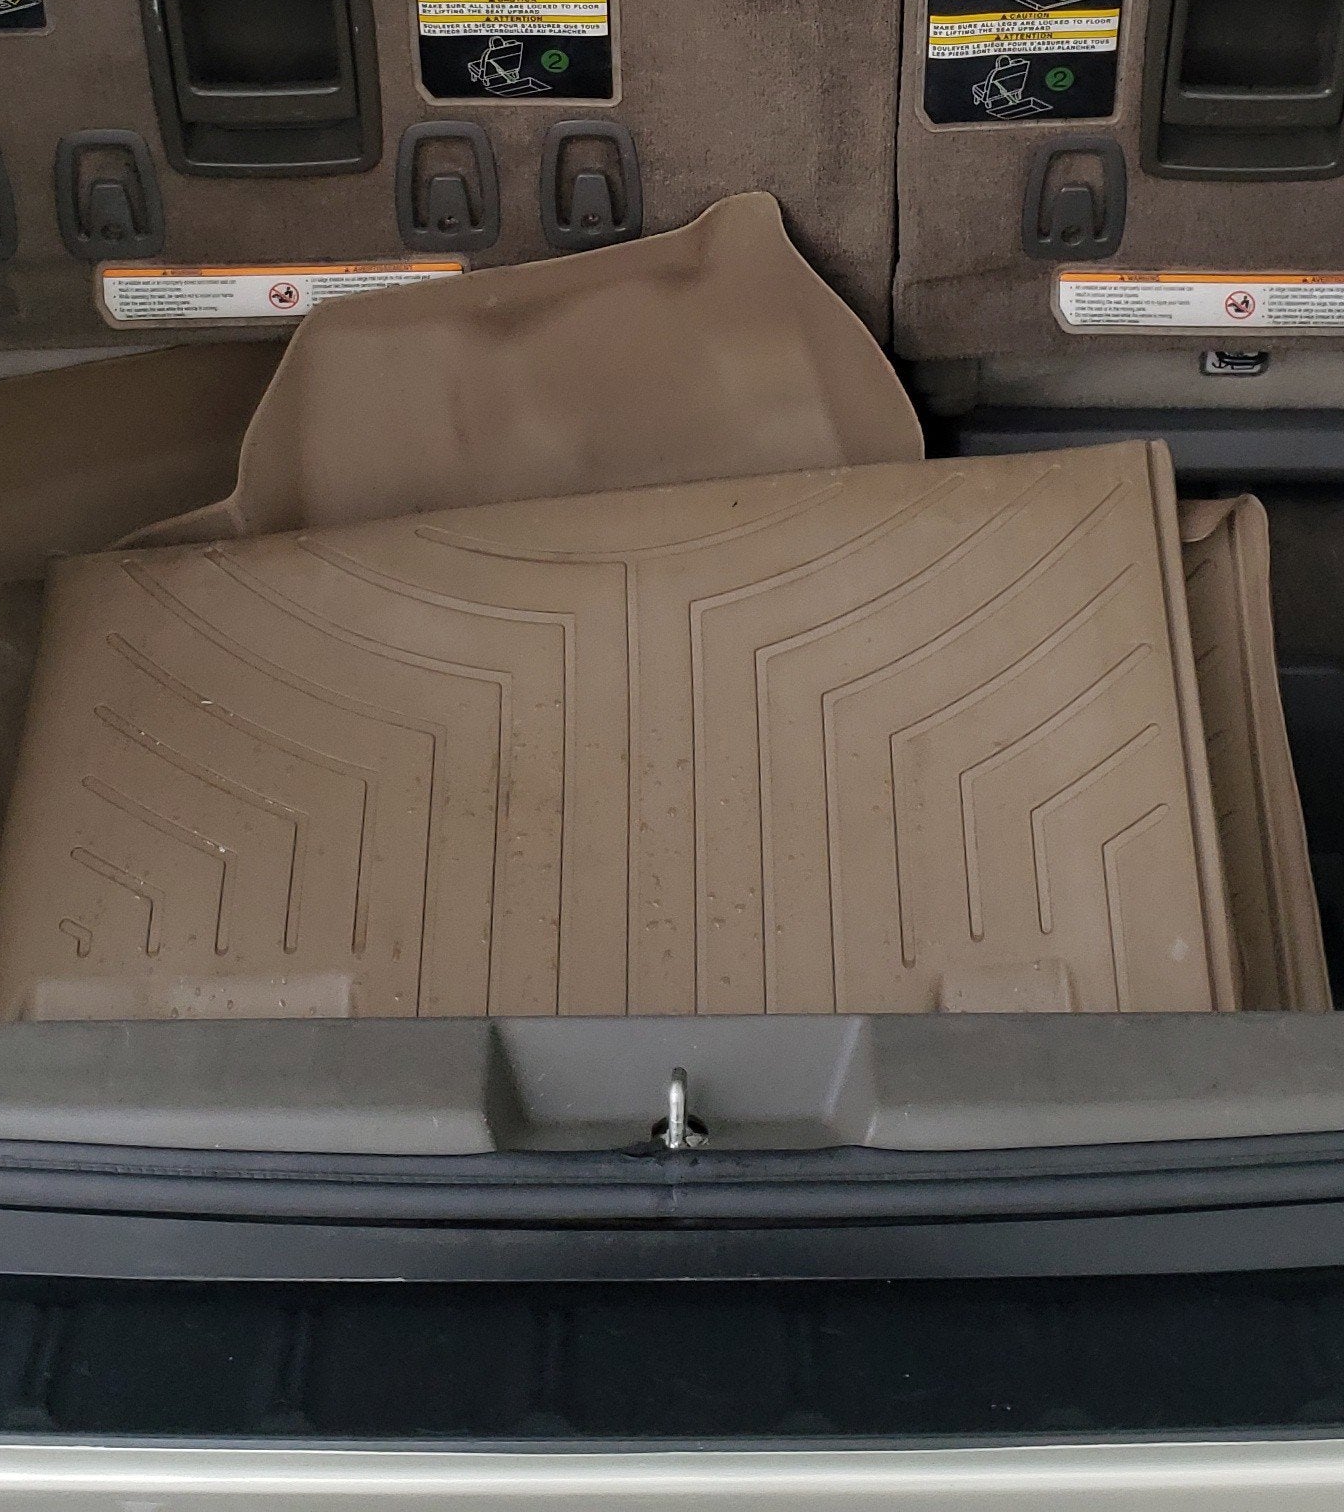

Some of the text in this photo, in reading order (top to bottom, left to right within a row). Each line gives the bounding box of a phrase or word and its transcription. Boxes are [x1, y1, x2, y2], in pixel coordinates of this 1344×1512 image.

[1004, 32, 1053, 40] ATTENTION
[548, 53, 562, 69] 2
[1053, 71, 1068, 88] 2
